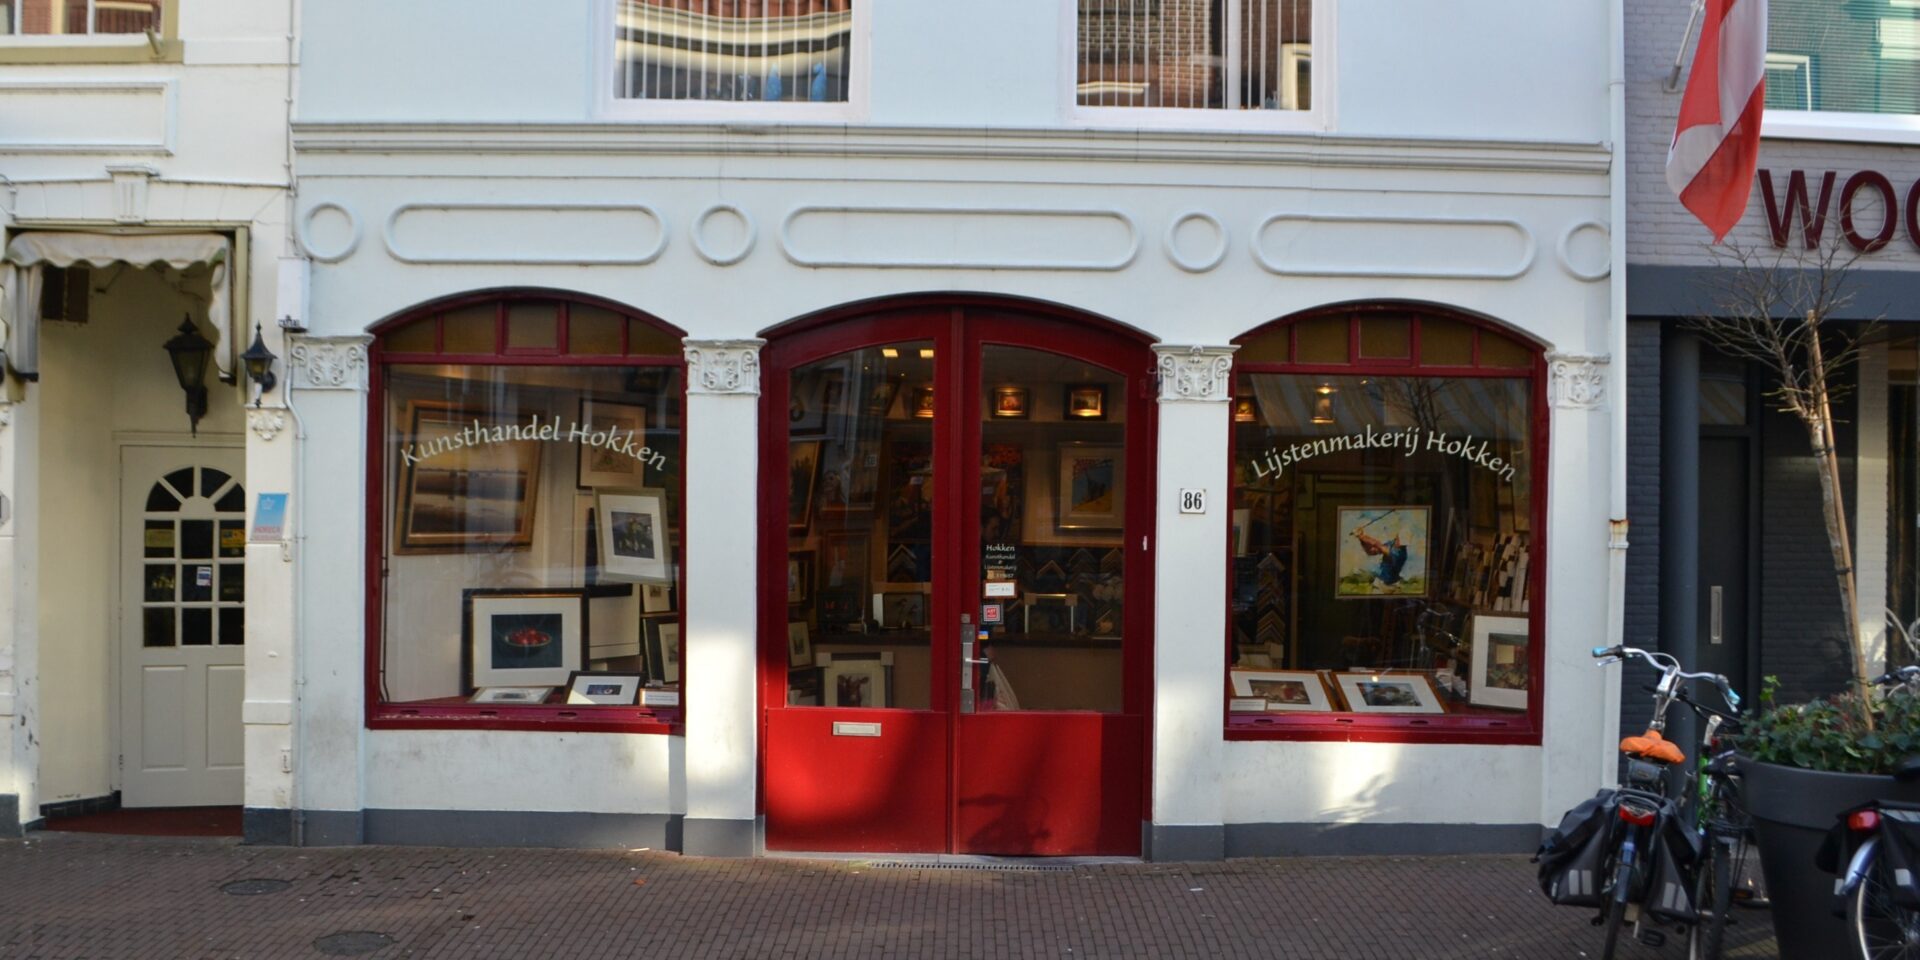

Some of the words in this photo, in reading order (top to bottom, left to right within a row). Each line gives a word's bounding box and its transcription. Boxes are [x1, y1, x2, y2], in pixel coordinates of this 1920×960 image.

[1757, 168, 1920, 254] WO
[400, 414, 560, 467] Kunsthandel
[568, 422, 666, 471] Hokken
[1251, 424, 1420, 479] Lijstenmakerij
[1426, 430, 1516, 482] Hokken
[1184, 491, 1202, 510] 86
